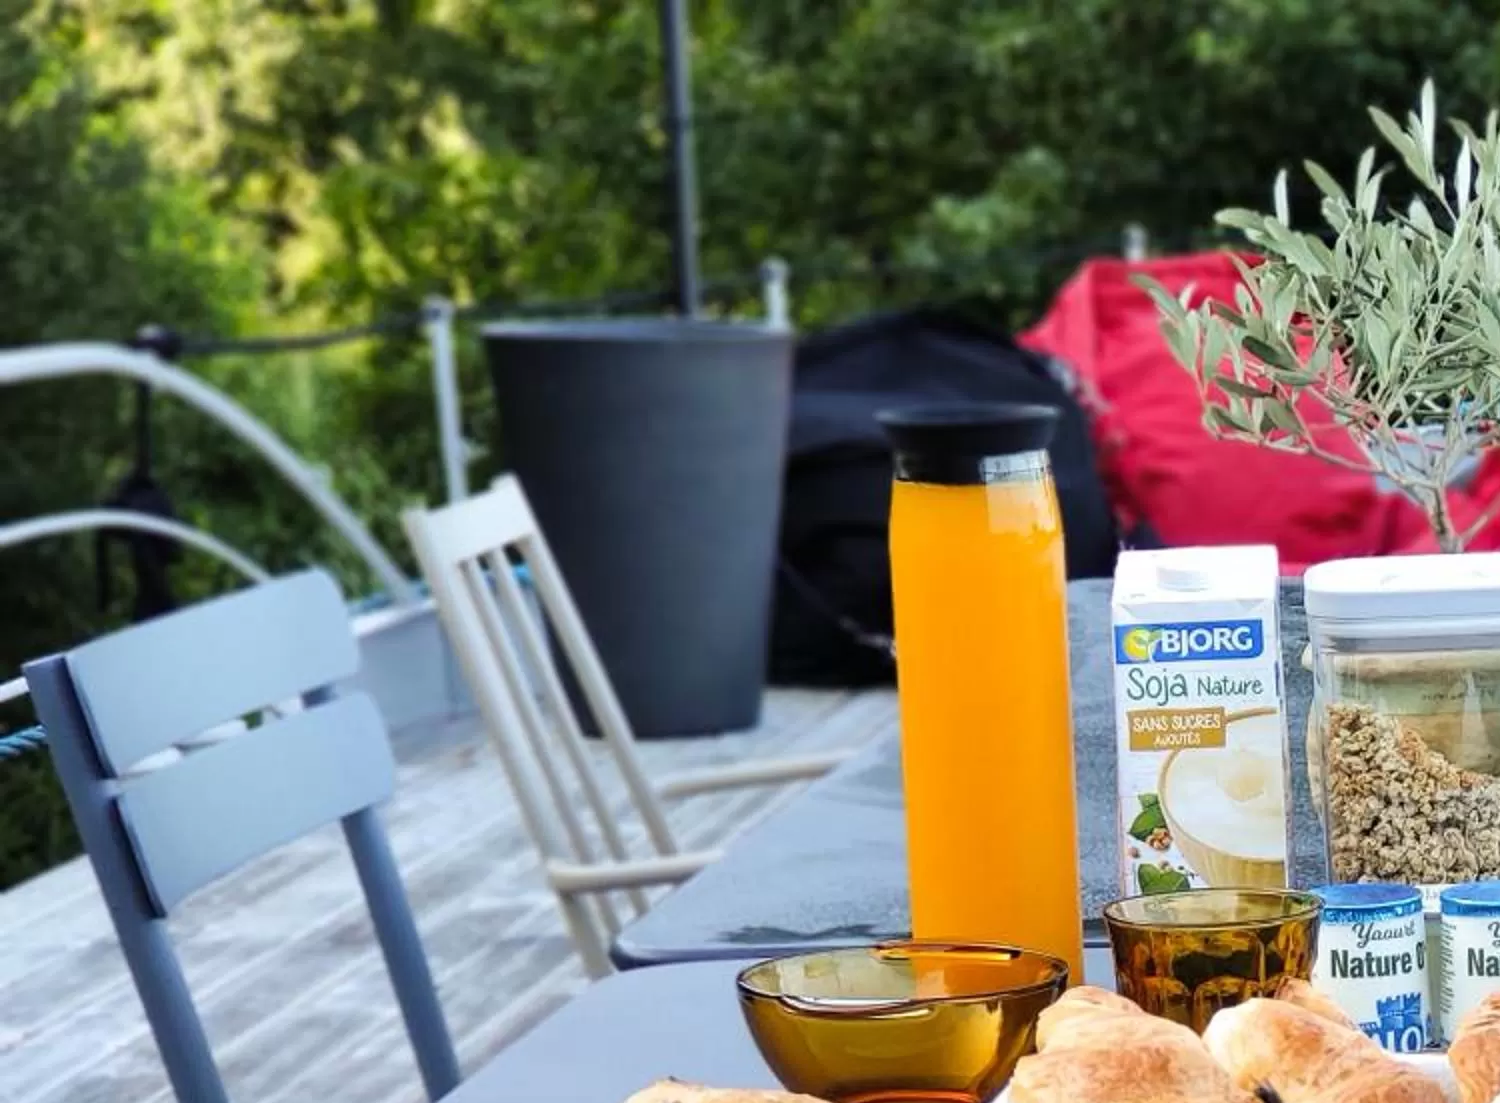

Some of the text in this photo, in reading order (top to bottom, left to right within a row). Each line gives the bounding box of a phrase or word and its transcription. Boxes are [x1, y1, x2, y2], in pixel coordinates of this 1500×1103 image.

[1161, 626, 1253, 657] BJORG
[1126, 668, 1263, 706] Soja Nature
[1132, 715, 1169, 732] SANS
[1352, 919, 1415, 948] Yaourt
[1330, 949, 1413, 978] Nature
